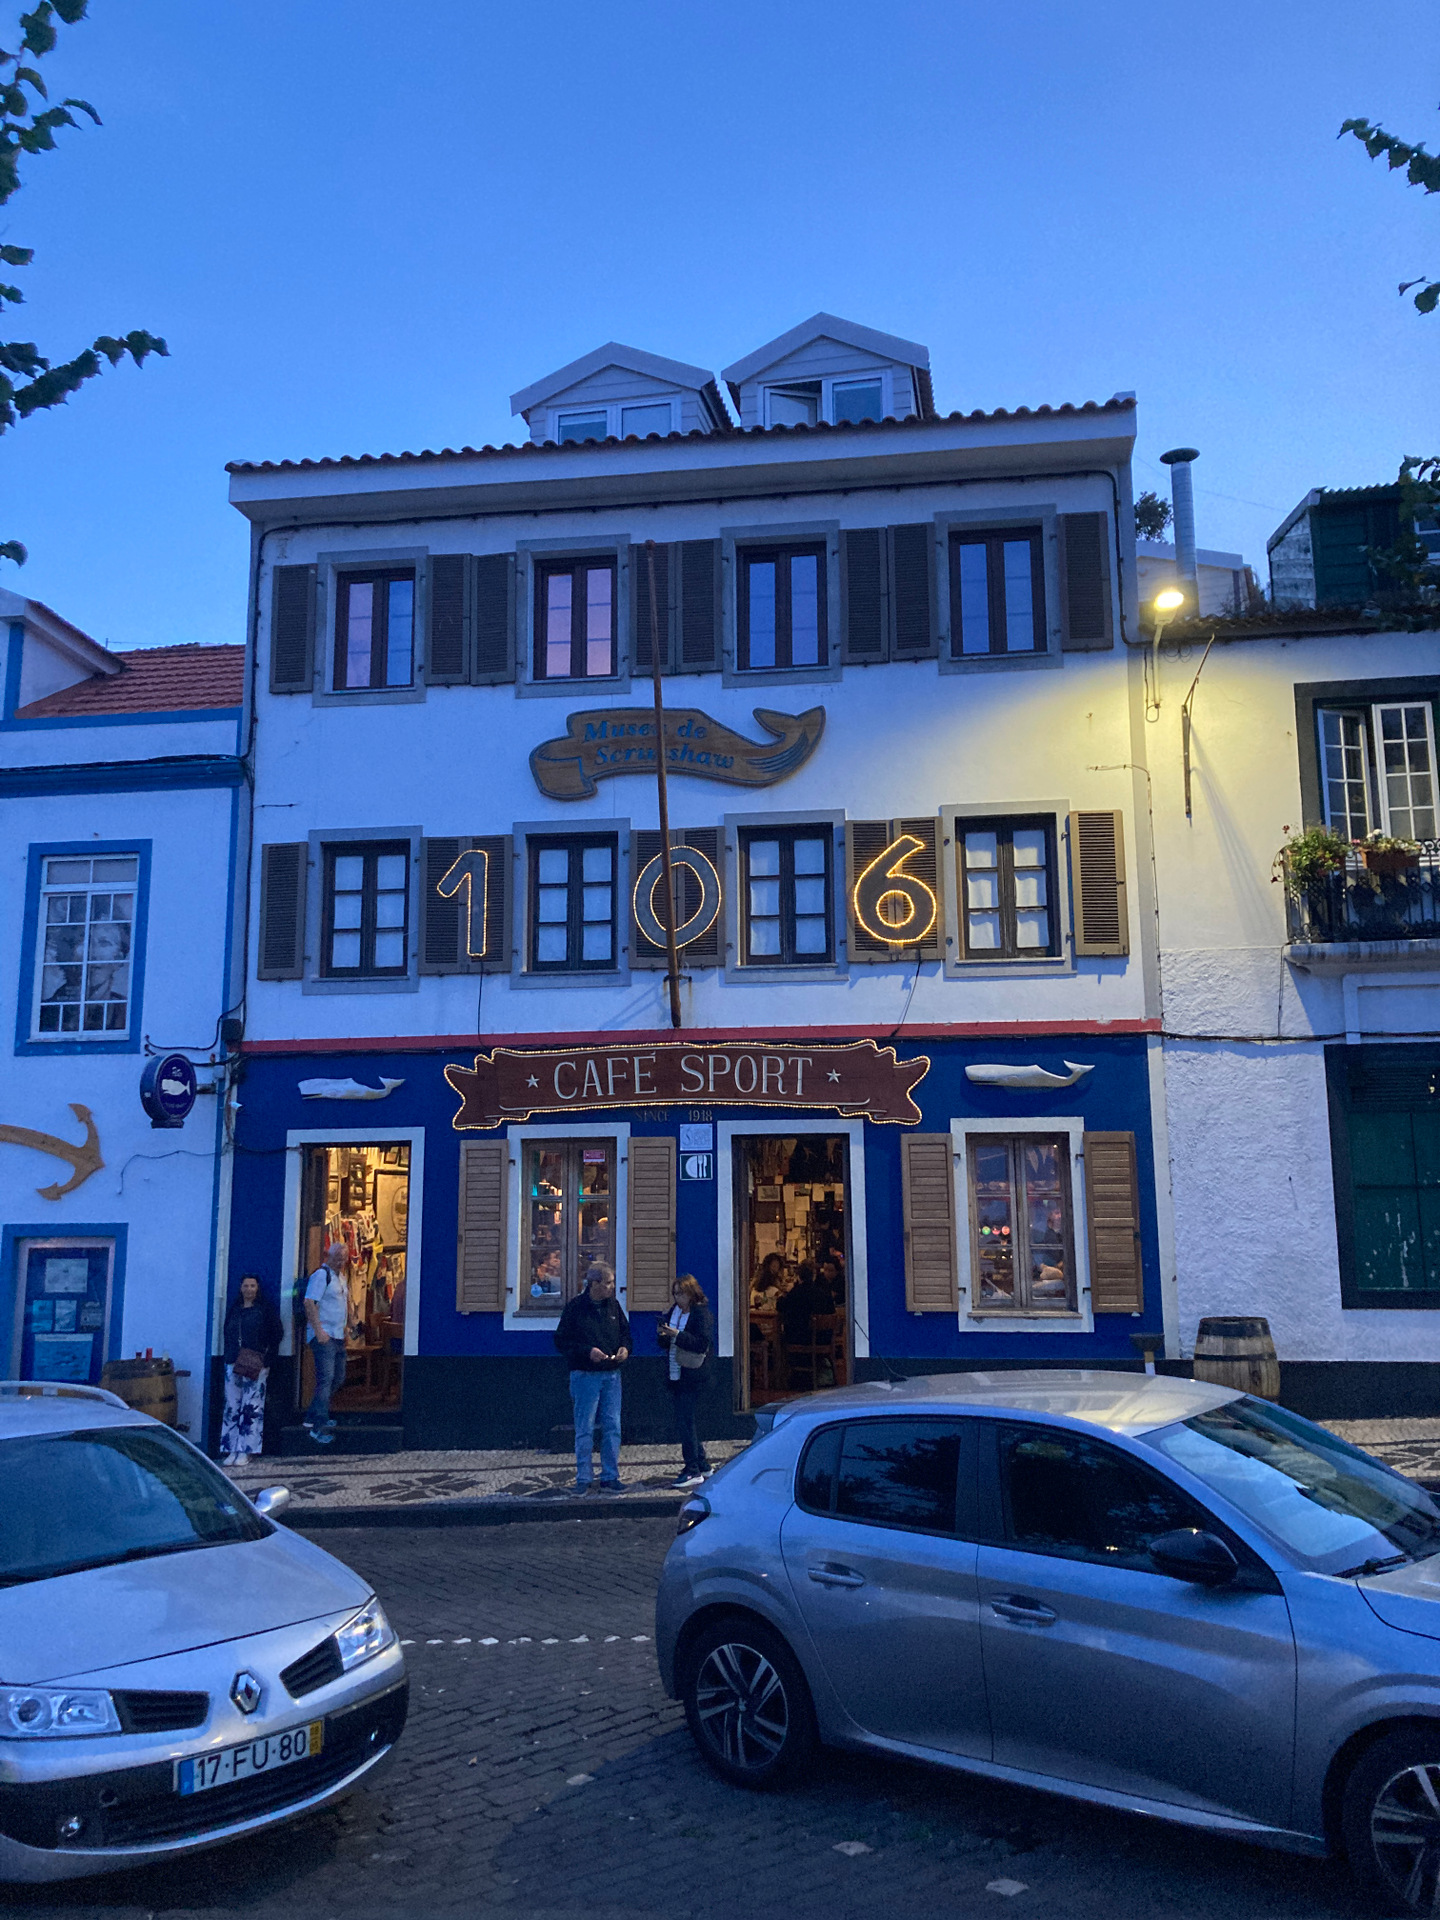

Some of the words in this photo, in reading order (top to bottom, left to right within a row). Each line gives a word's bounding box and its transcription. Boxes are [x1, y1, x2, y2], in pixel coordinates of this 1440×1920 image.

[677, 719, 708, 740] de
[553, 1050, 657, 1100] CAFÉ
[681, 1053, 813, 1097] SPORT
[635, 1109, 670, 1122] SINCE
